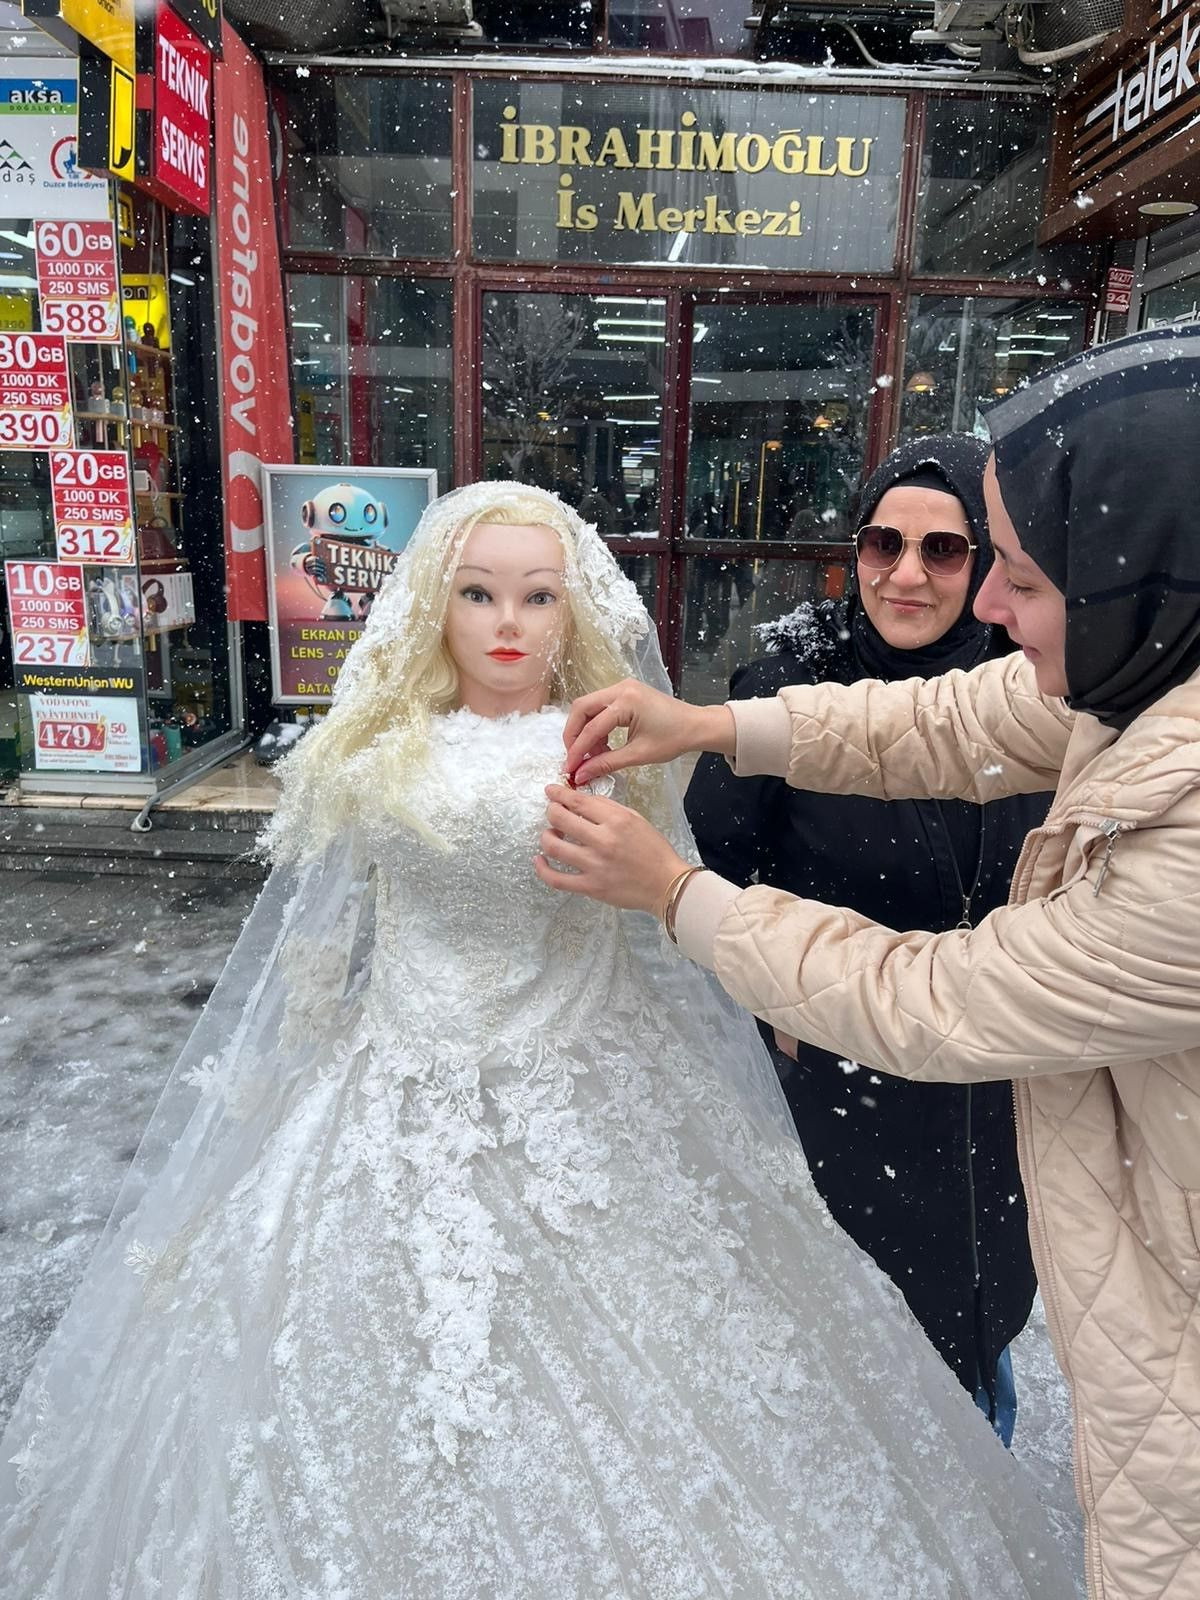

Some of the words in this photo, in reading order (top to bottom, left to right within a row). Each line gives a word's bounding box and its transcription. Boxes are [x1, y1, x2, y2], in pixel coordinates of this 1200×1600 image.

[1085, 12, 1200, 142] telek
[10, 89, 63, 104] aksa
[617, 191, 803, 236] Merkezi
[48, 262, 80, 276] 1000
[84, 263, 106, 276] DK
[49, 281, 74, 294] 250
[77, 281, 110, 295] SMS
[46, 303, 107, 334] 588
[1, 374, 34, 387] 1000
[37, 375, 59, 388] DK
[2, 392, 27, 404] 250
[31, 393, 63, 405] SMS
[0, 413, 60, 443] 390
[63, 490, 95, 502] 1000
[99, 491, 121, 504] DK
[64, 508, 88, 520] 250
[92, 509, 125, 521] SMS
[60, 527, 121, 556] 312
[334, 565, 385, 589] SERV
[20, 600, 51, 612] 1000
[54, 601, 76, 613] DK
[21, 617, 45, 628] 250
[48, 618, 80, 630] SMS
[301, 628, 346, 641] EKRAN
[18, 635, 75, 663] 237
[291, 647, 325, 659] LENS
[39, 698, 92, 708] VODAFONE
[110, 722, 128, 734] 50
[39, 724, 92, 748] 479
